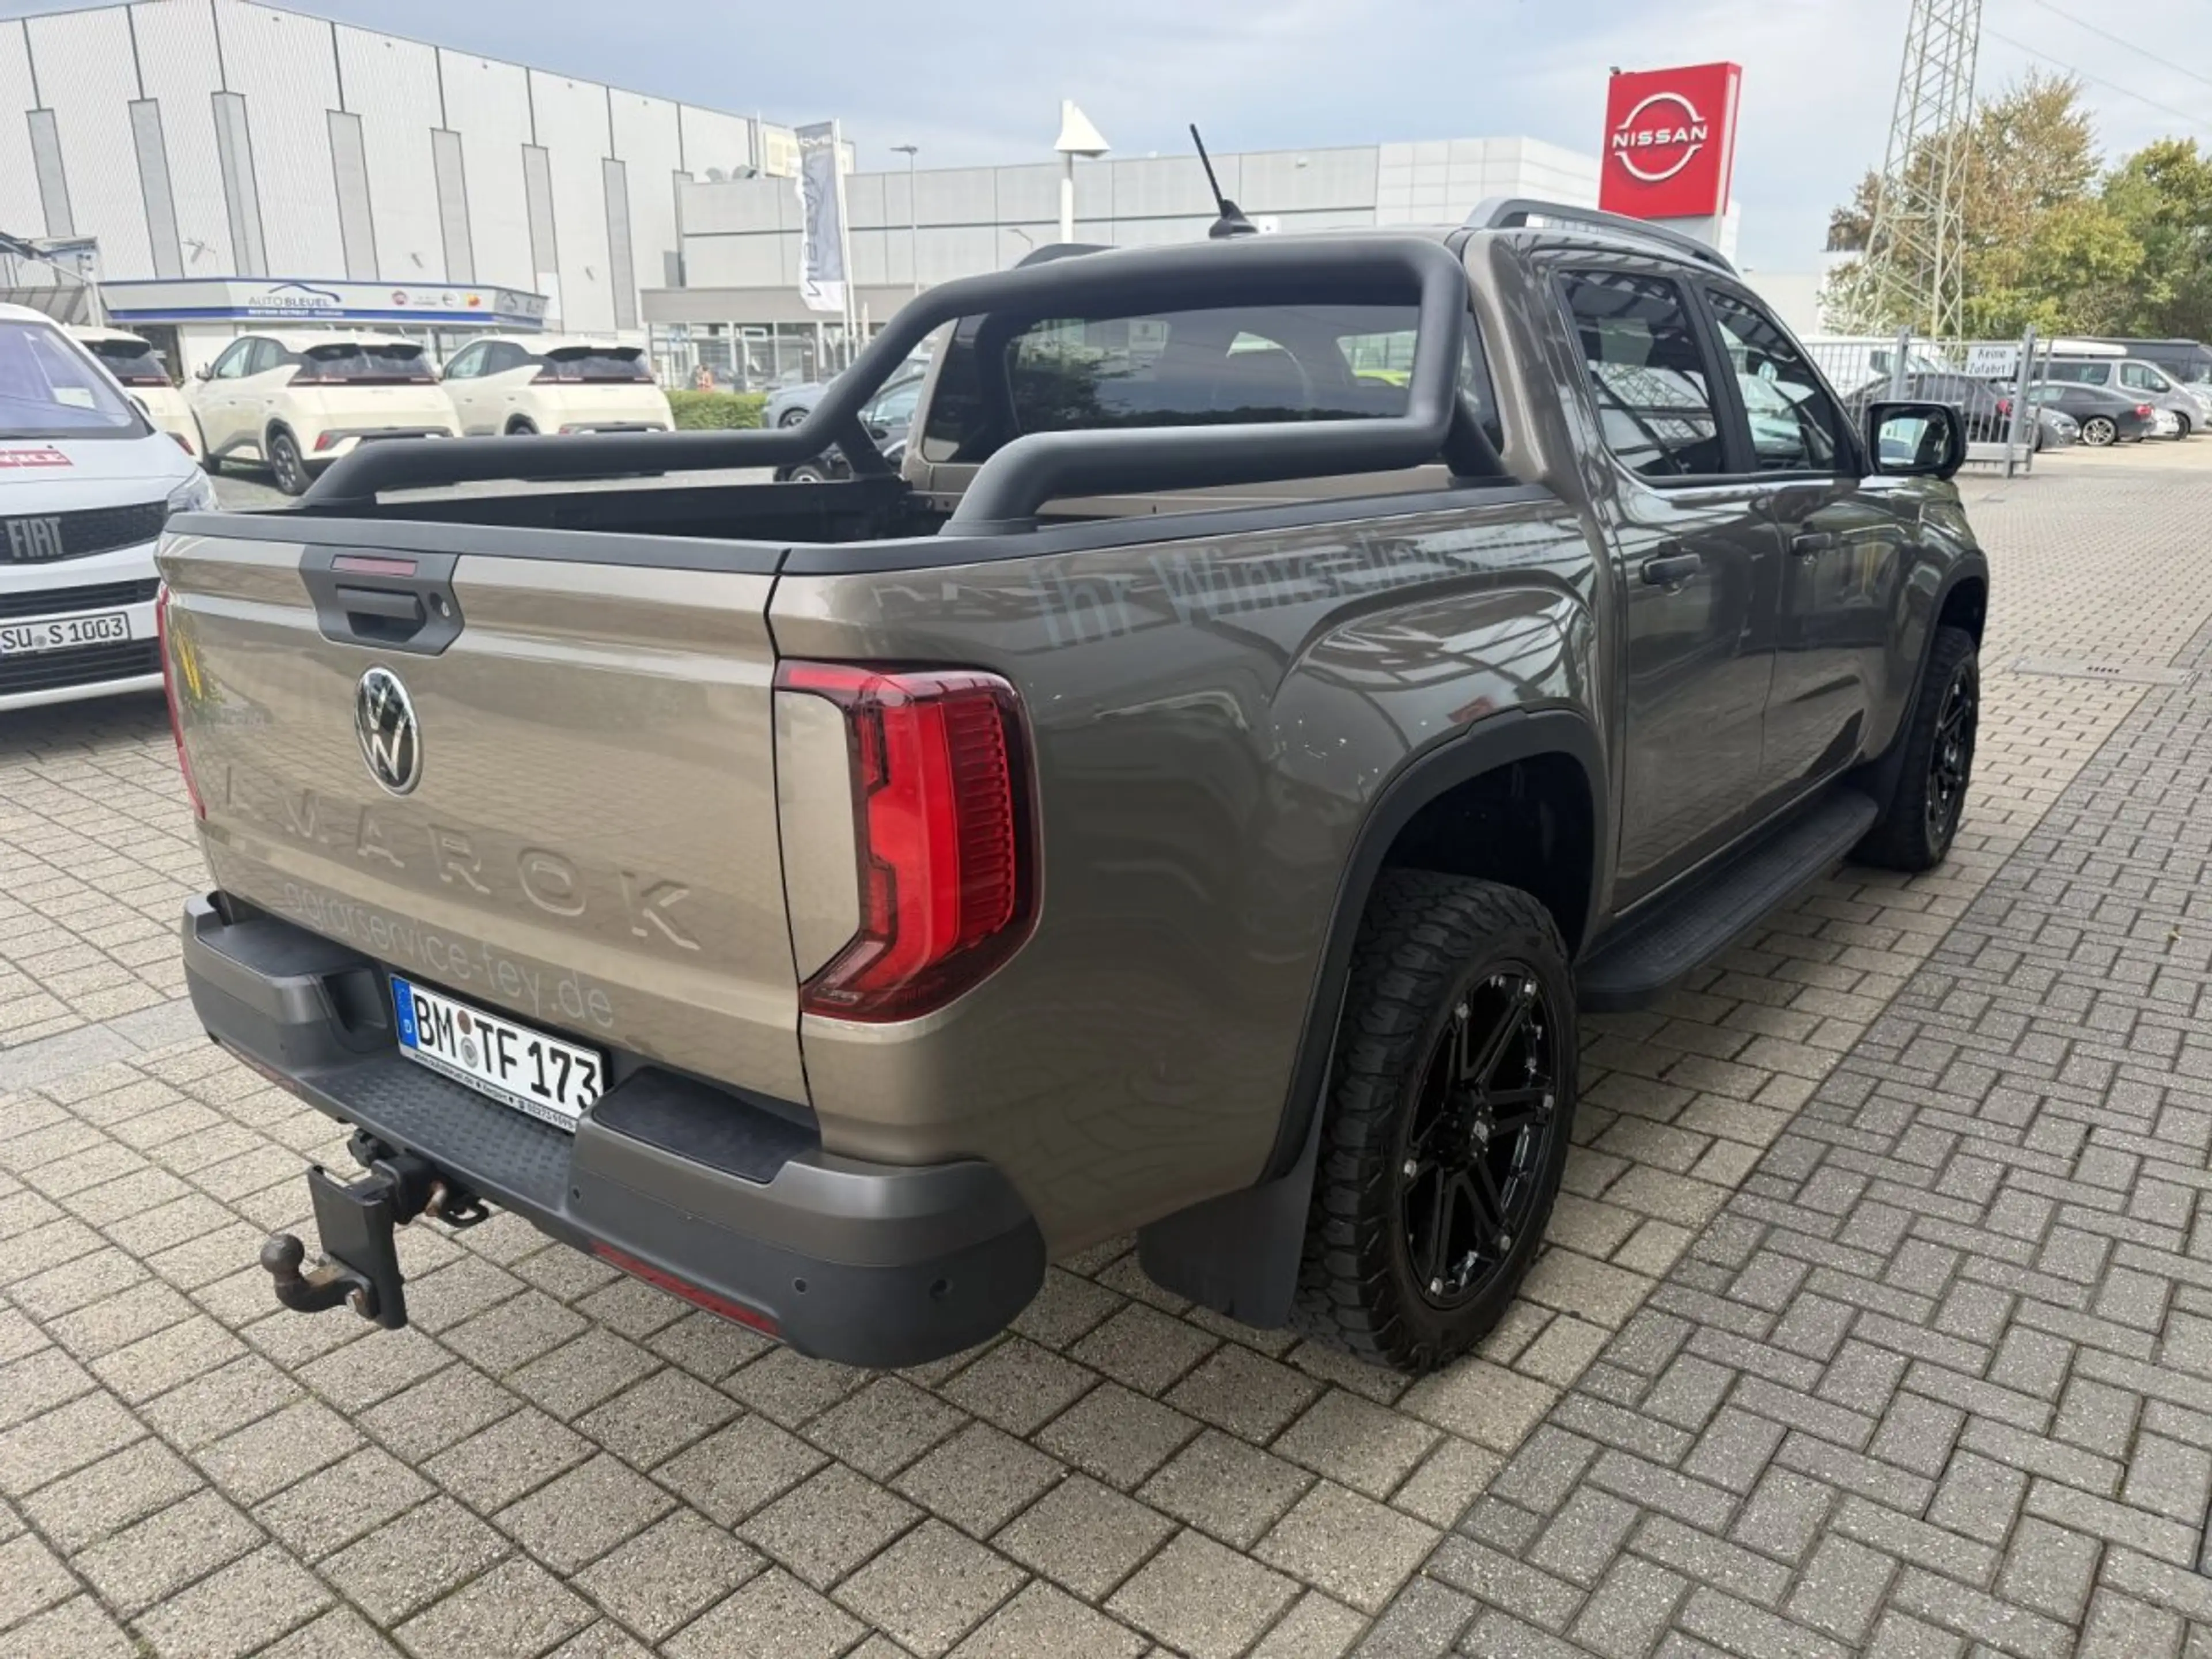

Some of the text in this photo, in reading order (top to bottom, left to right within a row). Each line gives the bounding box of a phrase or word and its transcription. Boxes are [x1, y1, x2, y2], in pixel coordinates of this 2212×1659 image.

[1612, 125, 1708, 148] NISSAN
[1978, 349, 2006, 361] Keine
[5, 517, 63, 558] FIAT
[1, 618, 123, 650] SU S 1003
[283, 881, 616, 1029] agrarservice-fey.de
[412, 994, 599, 1109] BM TF 173
